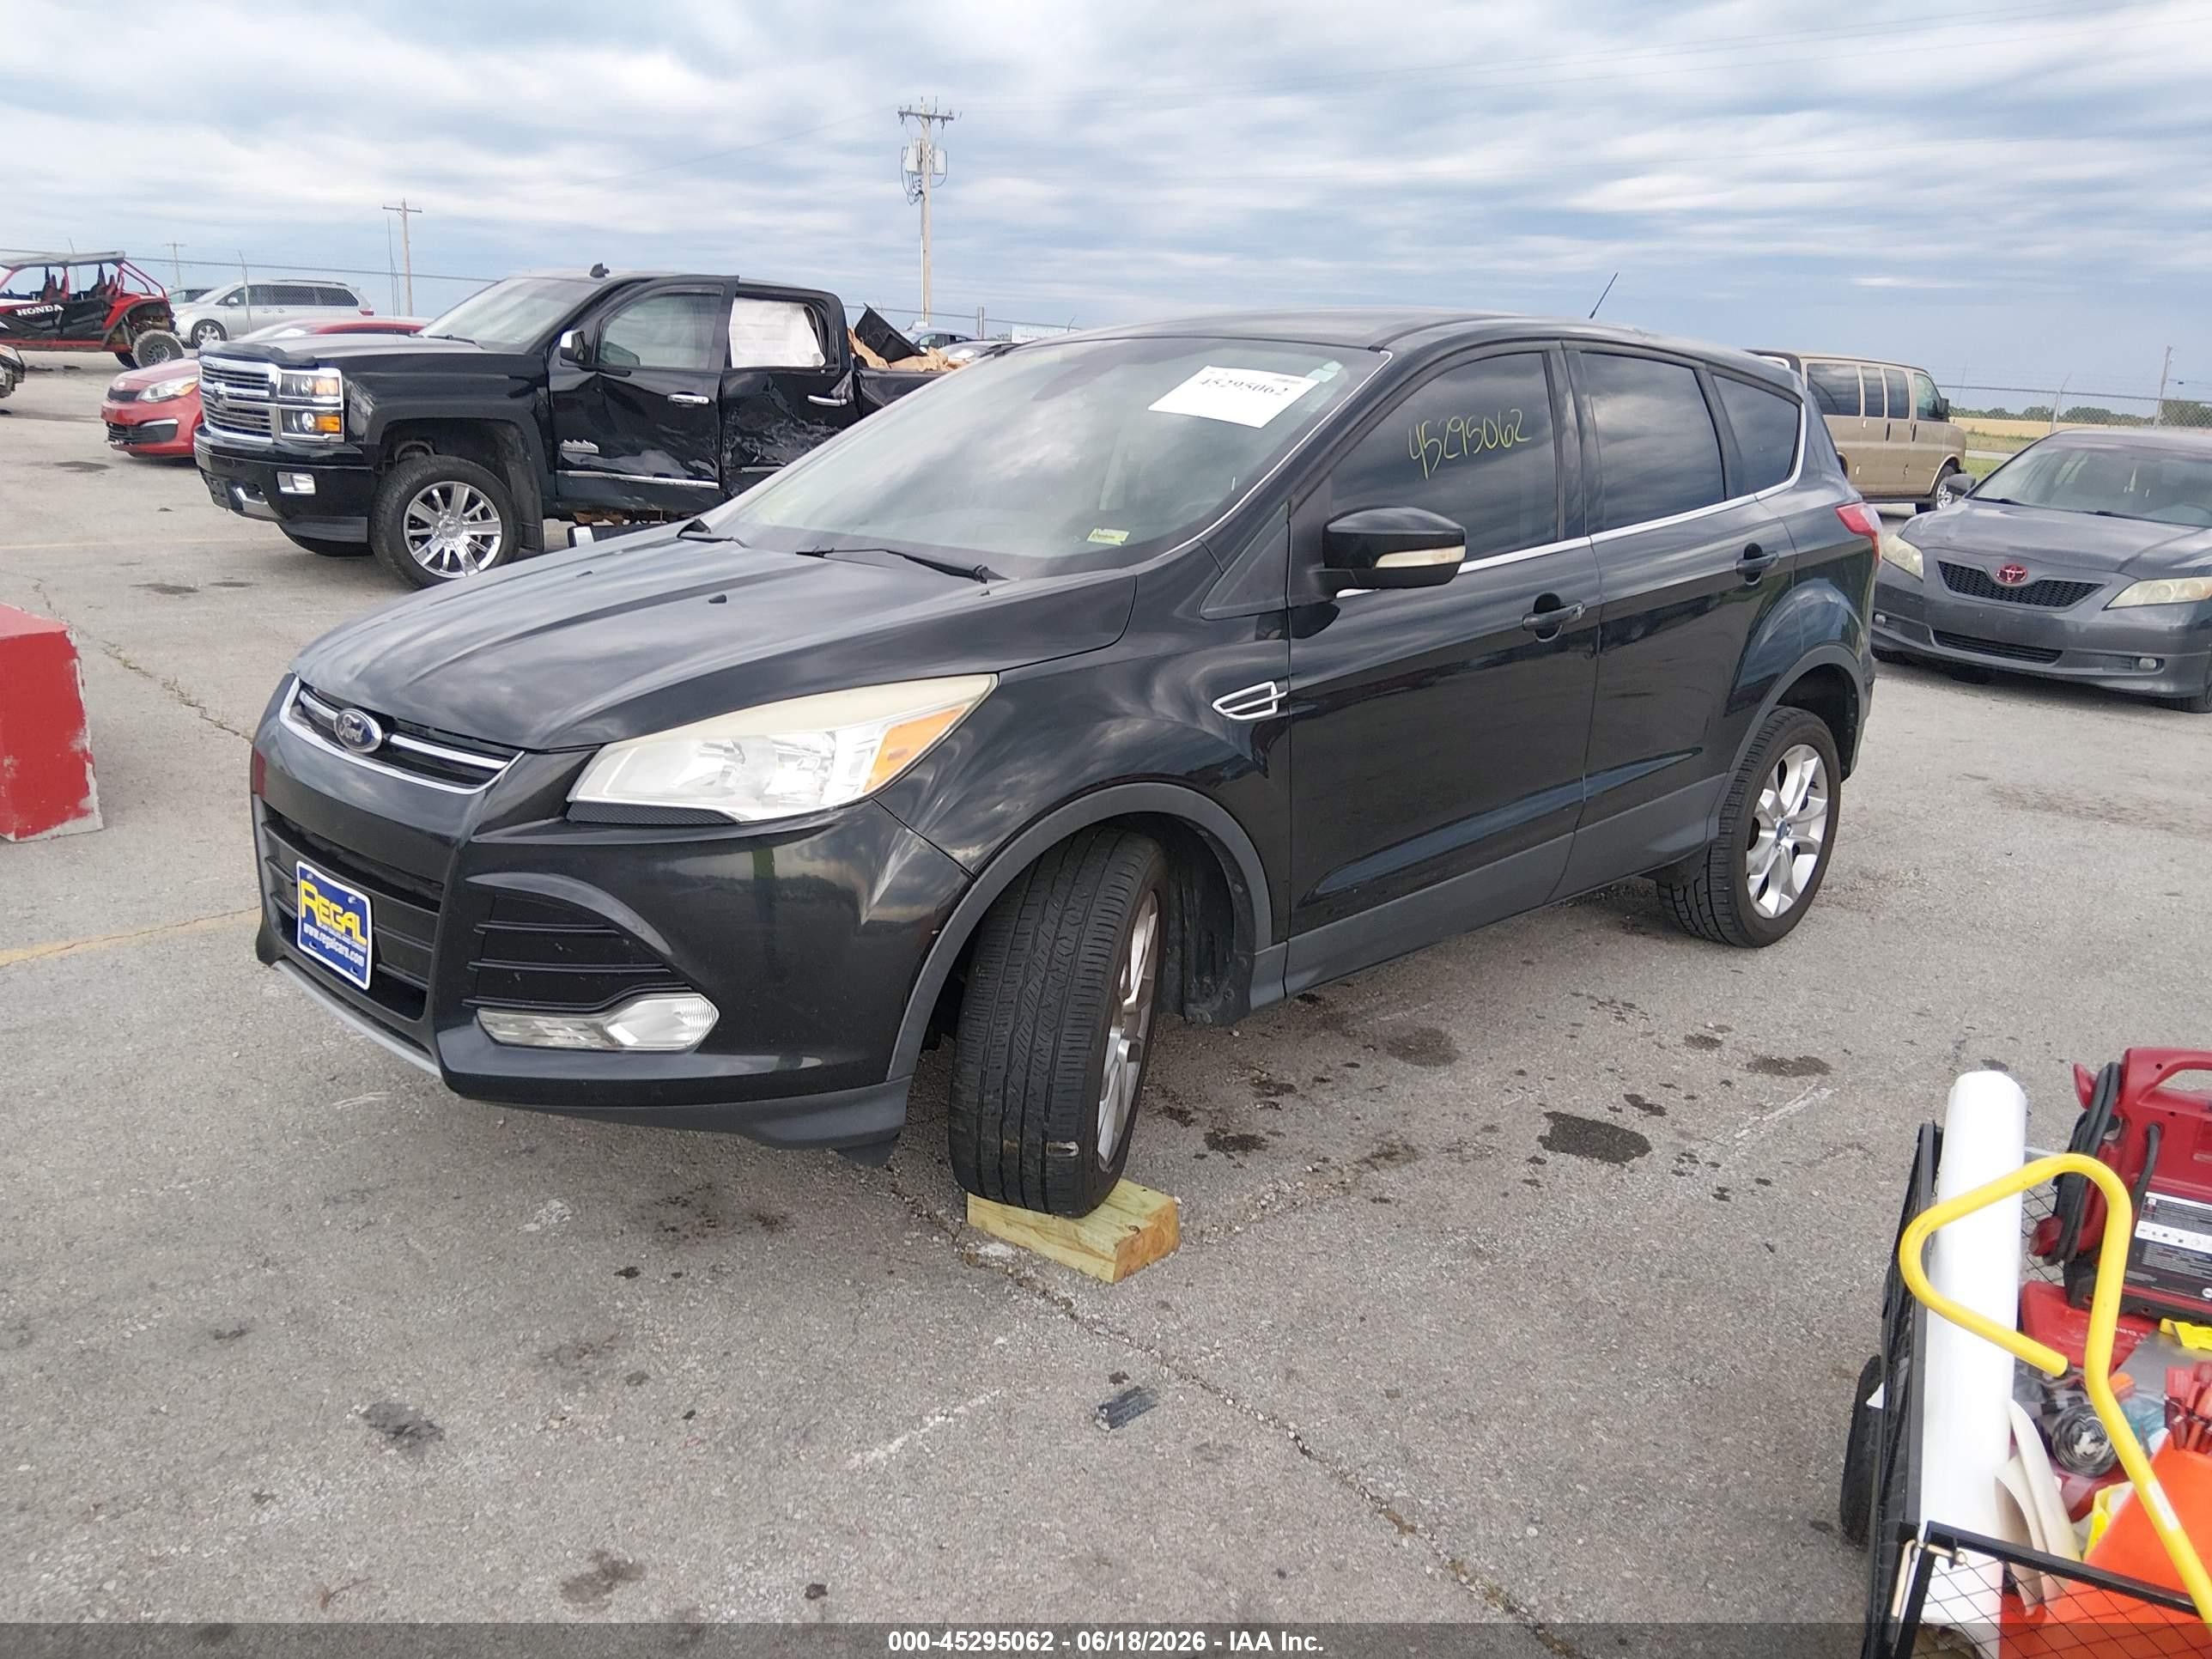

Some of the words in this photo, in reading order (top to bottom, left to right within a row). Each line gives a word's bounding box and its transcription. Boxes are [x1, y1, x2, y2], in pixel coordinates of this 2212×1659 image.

[15, 304, 65, 317] HONDA
[1407, 408, 1532, 480] 45295062
[338, 714, 366, 743] Ford
[300, 879, 368, 946] REGAL
